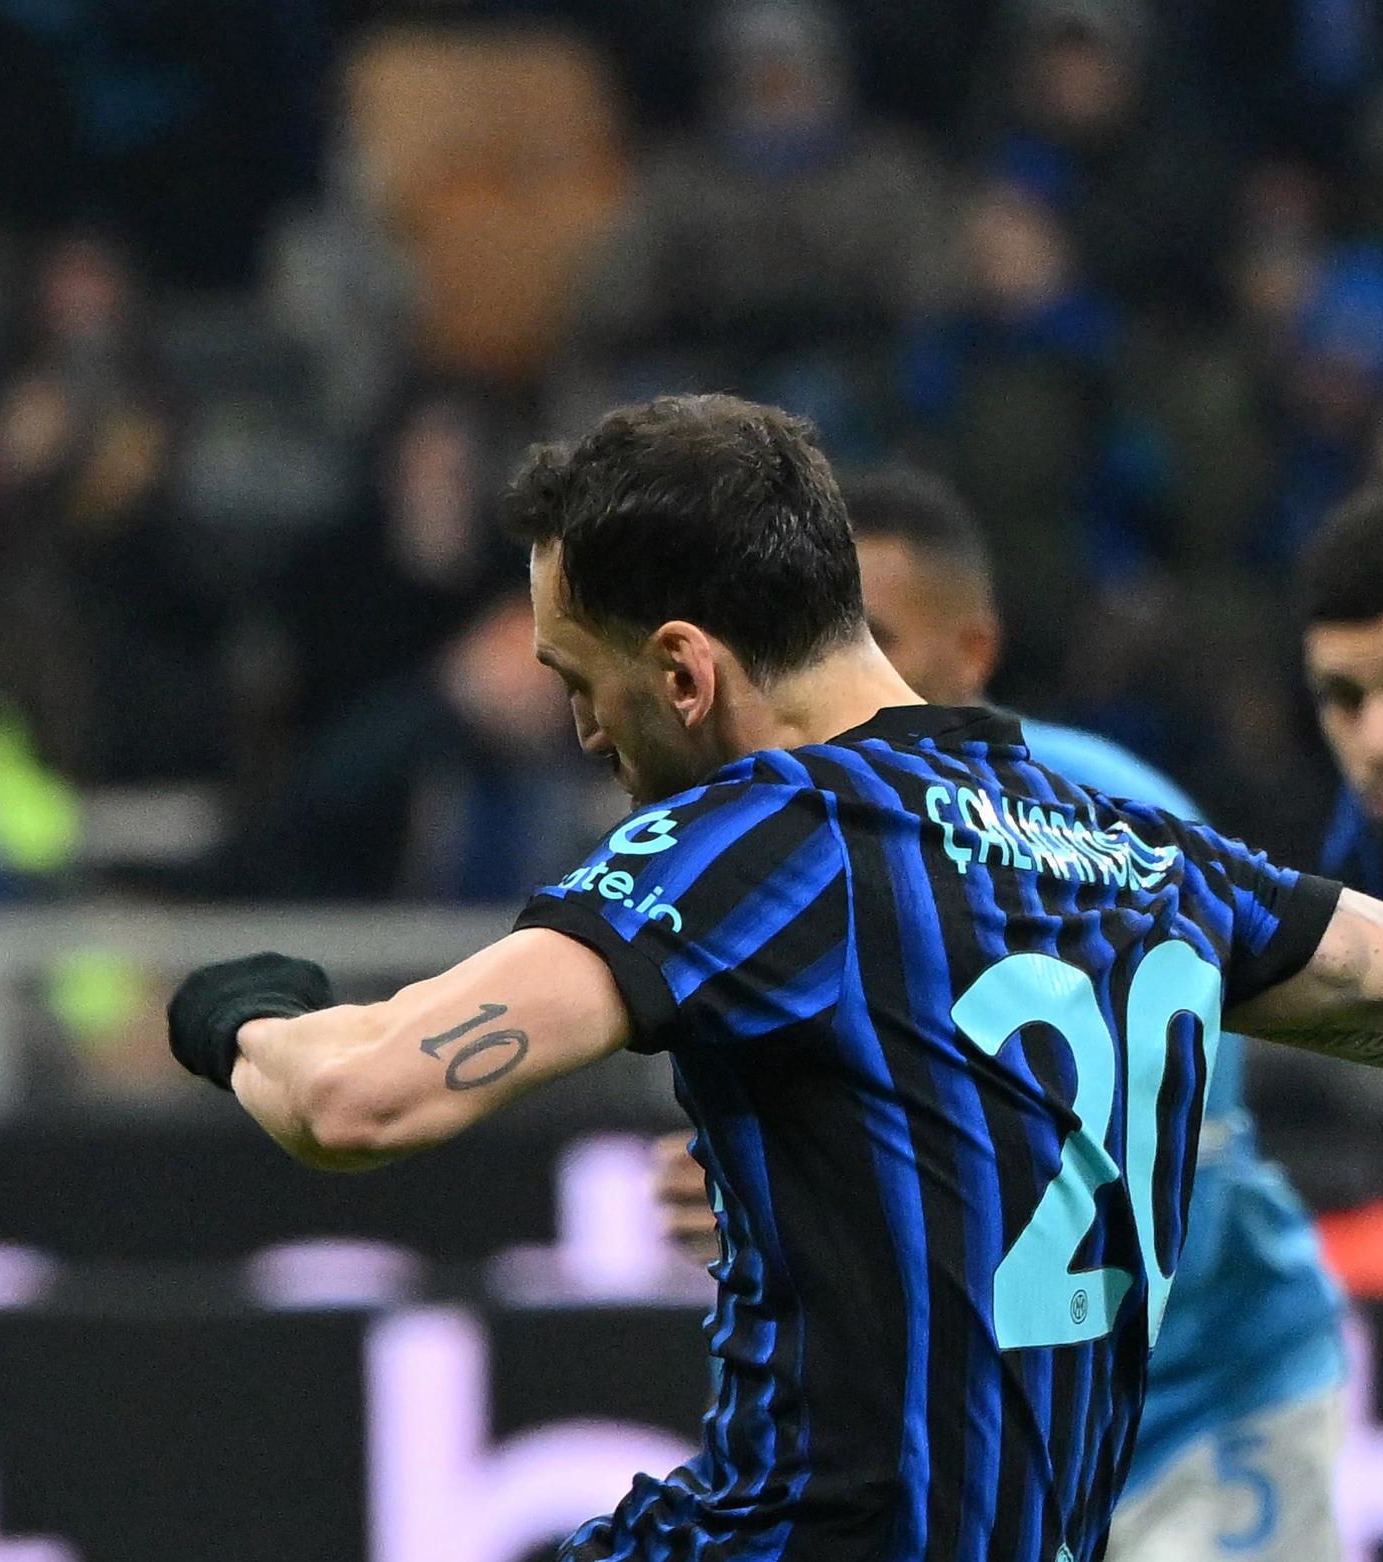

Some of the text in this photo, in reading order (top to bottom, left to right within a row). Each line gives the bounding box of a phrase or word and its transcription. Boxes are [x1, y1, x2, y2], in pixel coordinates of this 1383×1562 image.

[419, 1003, 529, 1091] 10
[950, 940, 1222, 1351] 20
[1215, 1432, 1281, 1555] 5
